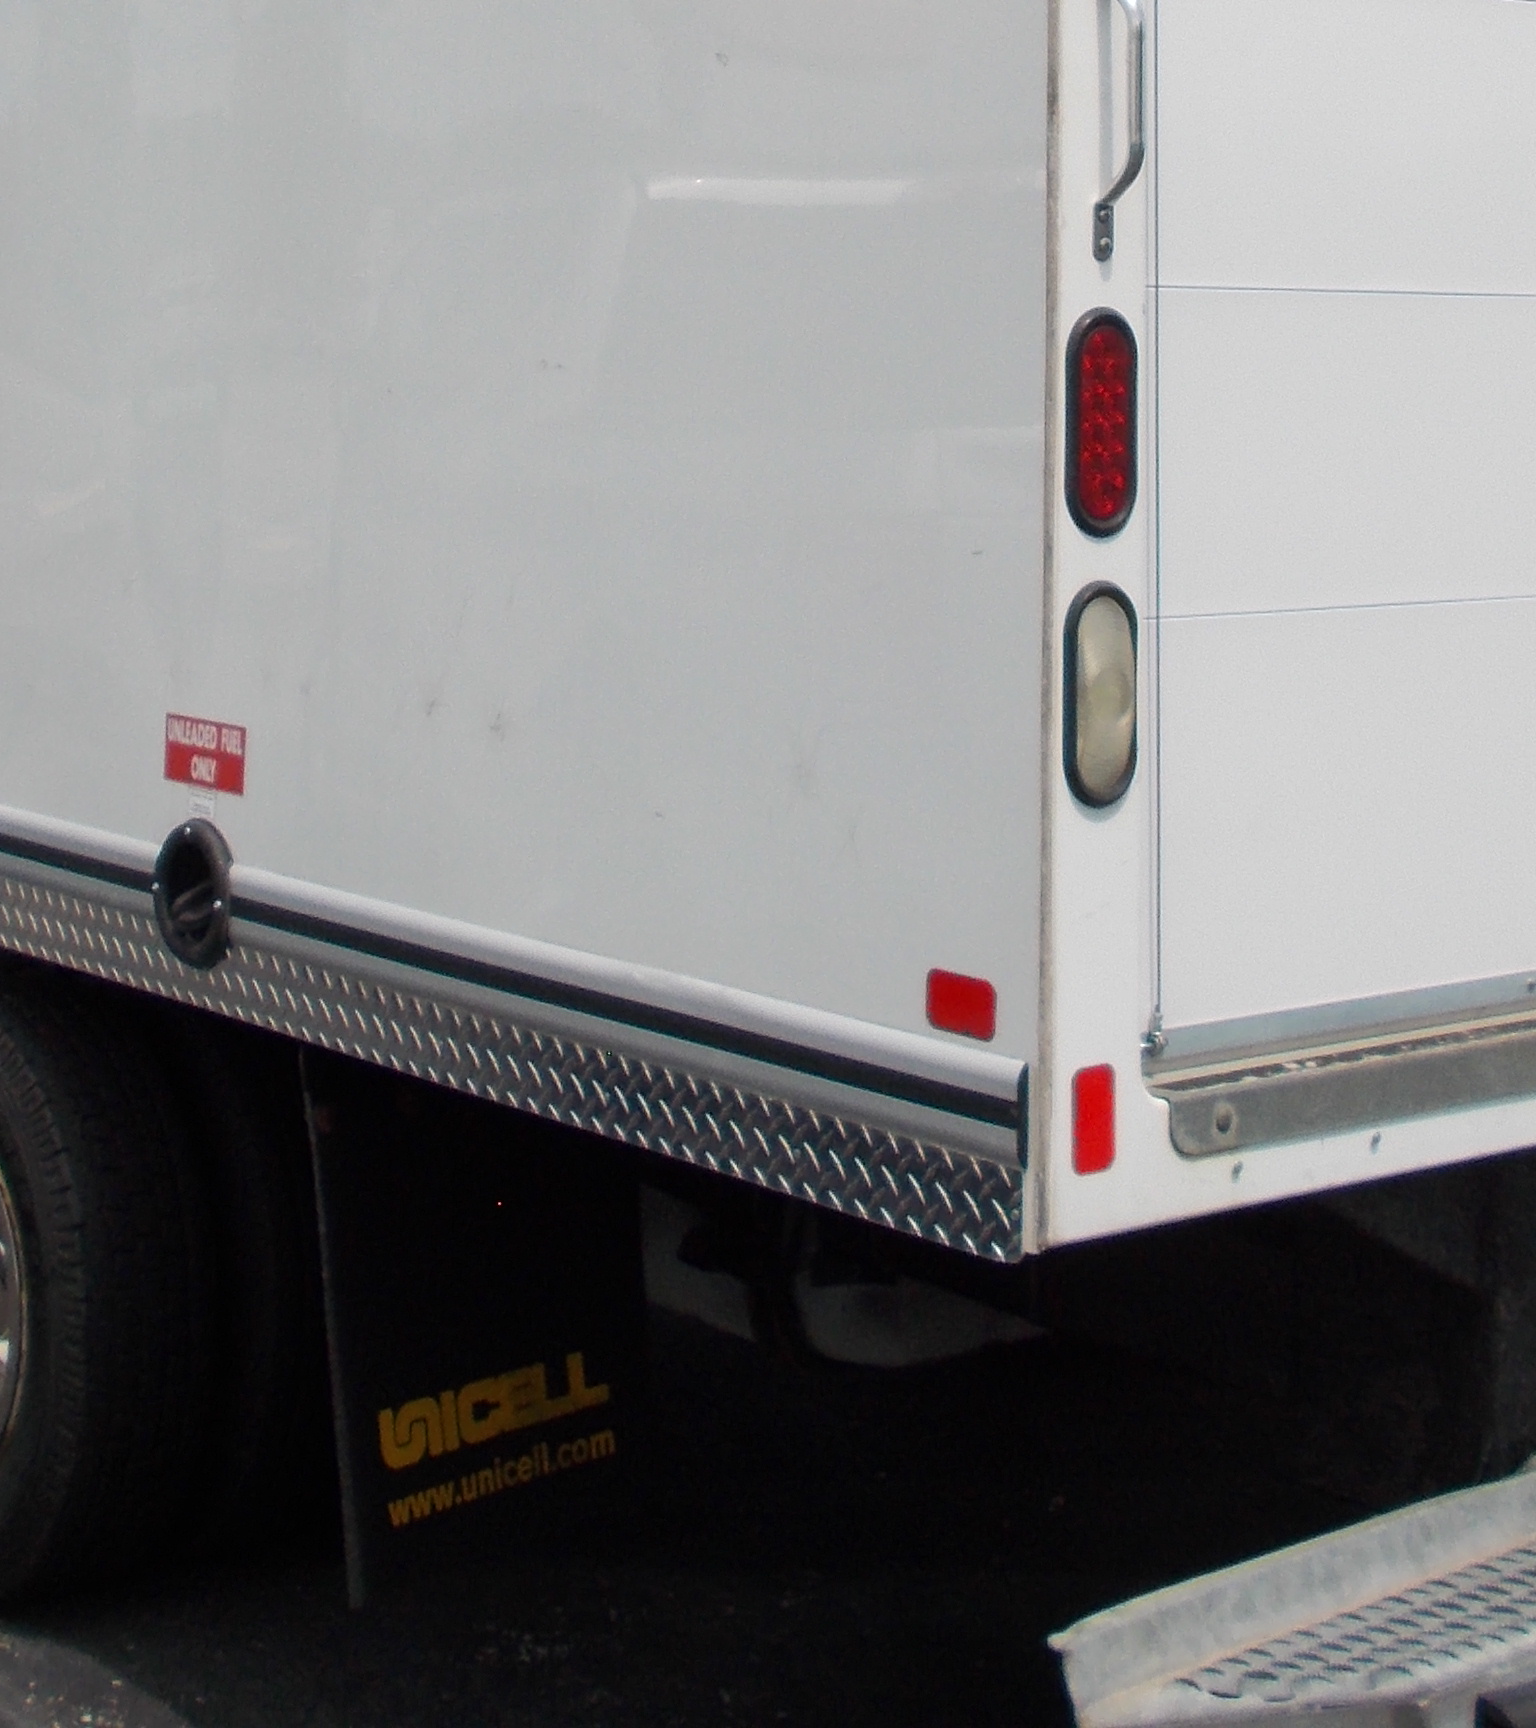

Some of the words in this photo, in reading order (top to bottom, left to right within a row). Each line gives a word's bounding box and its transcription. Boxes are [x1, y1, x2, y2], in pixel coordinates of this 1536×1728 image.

[167, 717, 217, 750] UNLEADED
[221, 728, 242, 755] FUEL
[190, 754, 217, 783] ONLY
[378, 1352, 609, 1469] UNICELL
[388, 1429, 615, 1527] www.unicell.com
